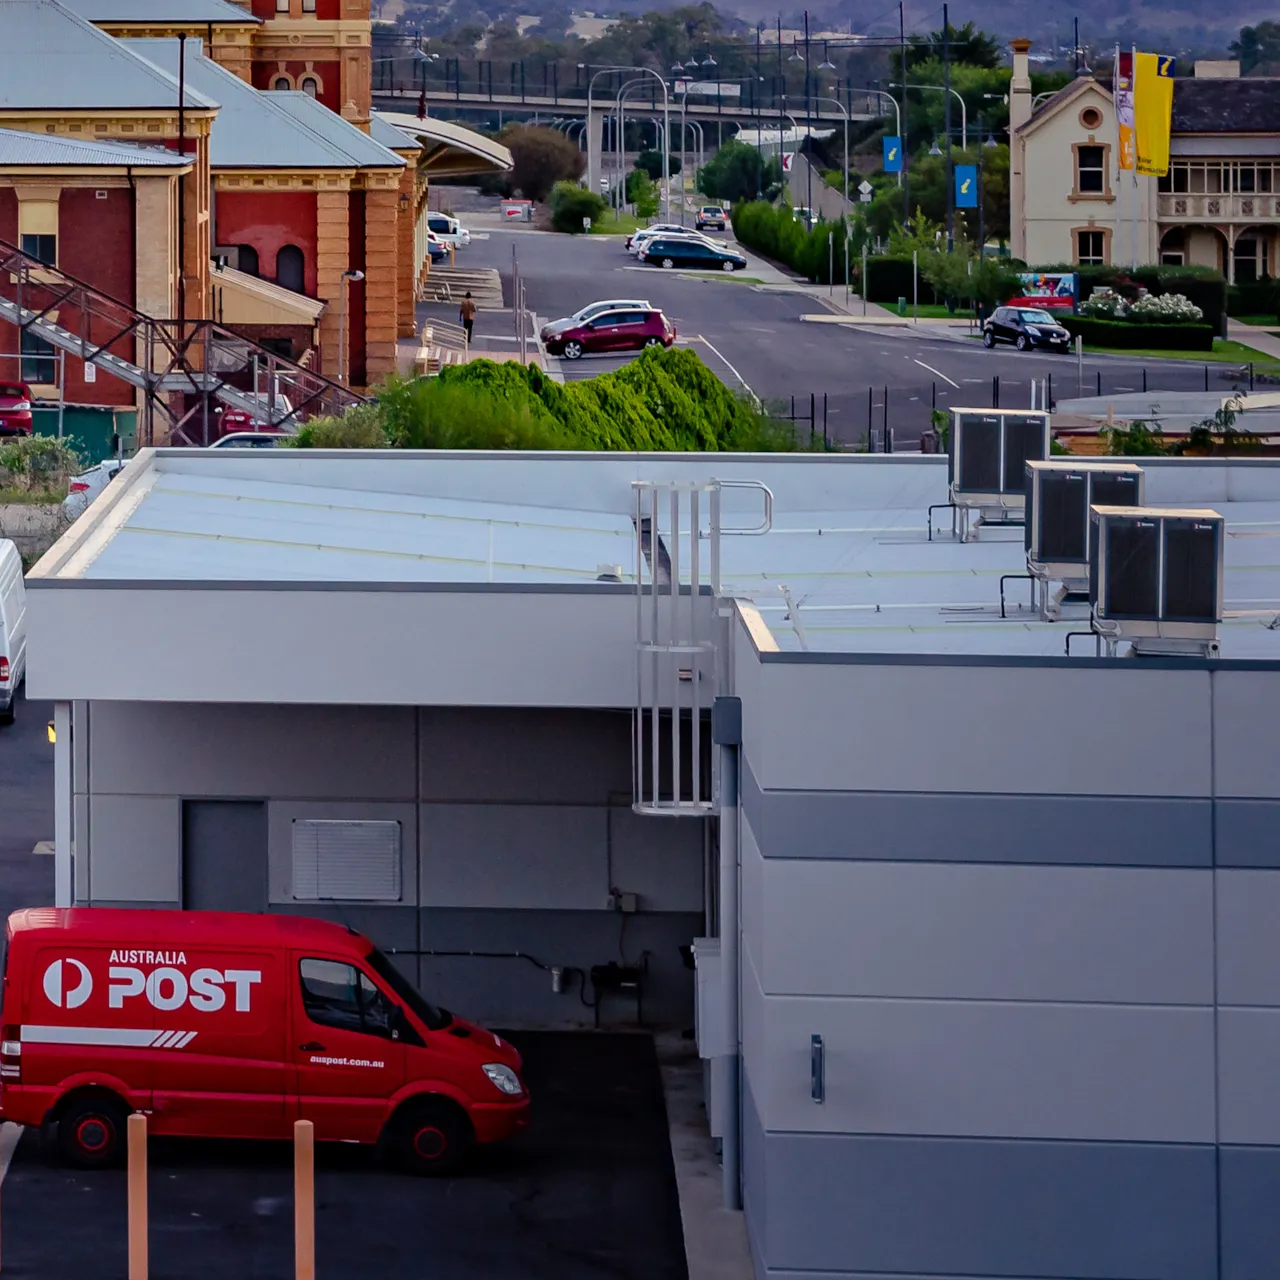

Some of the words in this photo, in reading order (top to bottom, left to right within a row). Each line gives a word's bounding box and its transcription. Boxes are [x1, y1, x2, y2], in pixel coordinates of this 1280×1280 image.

[109, 950, 187, 965] AUSTRALIA
[109, 967, 262, 1012] POST
[310, 1056, 384, 1068] auspost.com.au
